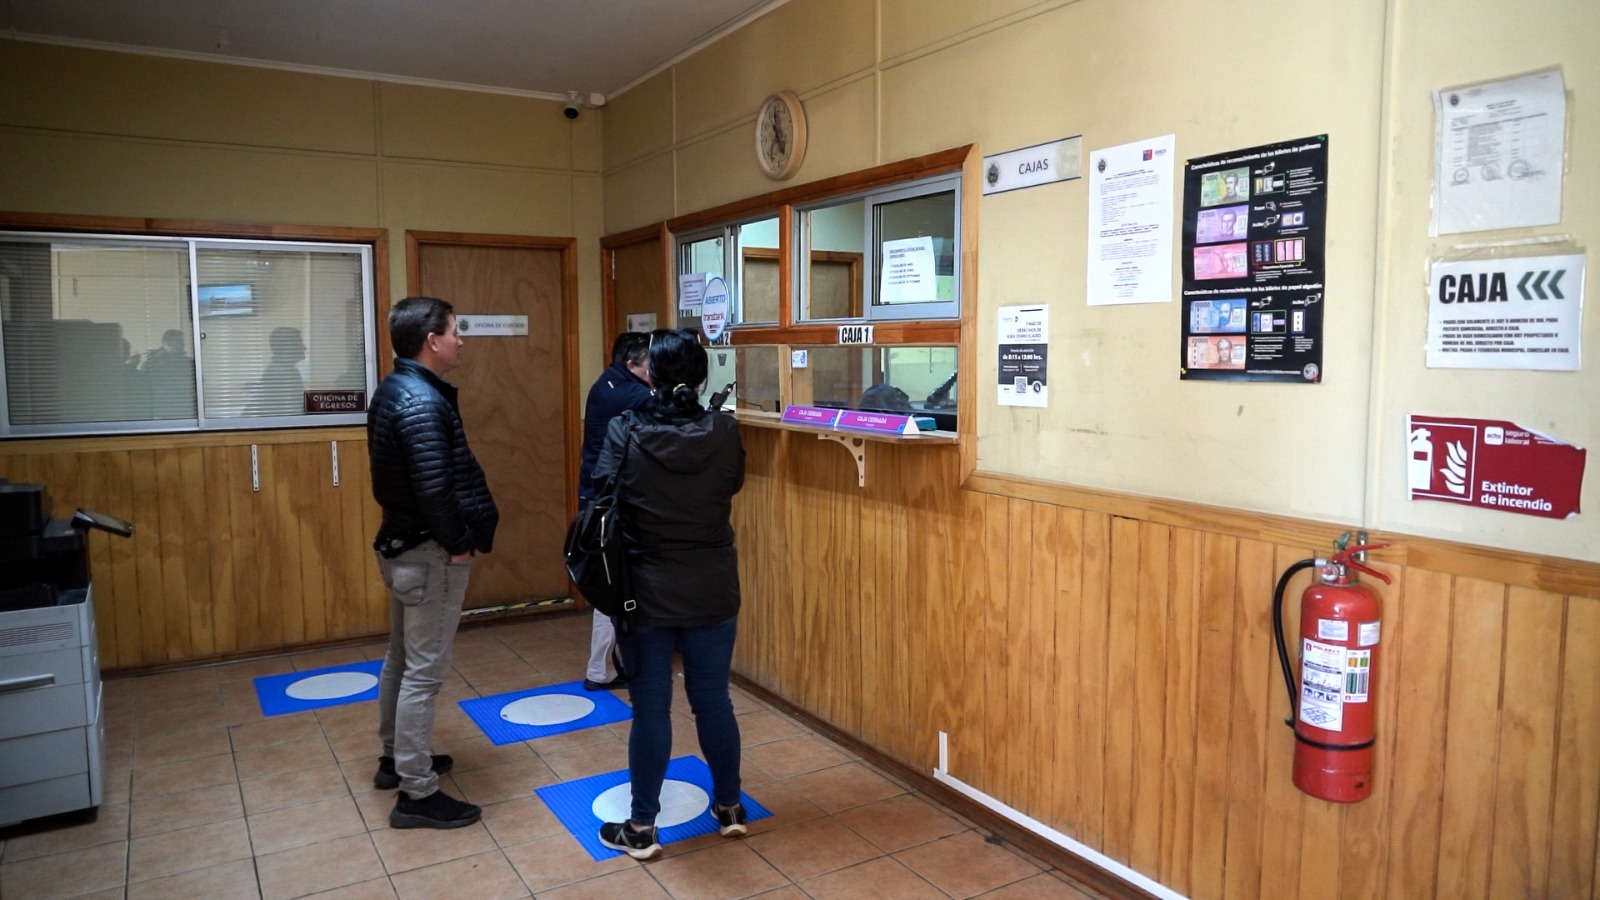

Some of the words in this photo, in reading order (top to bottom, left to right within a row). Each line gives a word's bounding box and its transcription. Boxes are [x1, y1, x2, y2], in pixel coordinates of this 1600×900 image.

[1018, 158, 1049, 175] CAJAS
[1226, 154, 1260, 164] reconocimiento
[1439, 272, 1508, 304] CAJA
[705, 294, 726, 304] ABIERTO
[842, 327, 862, 343] CAJA
[864, 327, 869, 342] 1
[1482, 480, 1534, 496] Extintor
[1481, 495, 1496, 505] de
[1498, 496, 1552, 511] incendio
